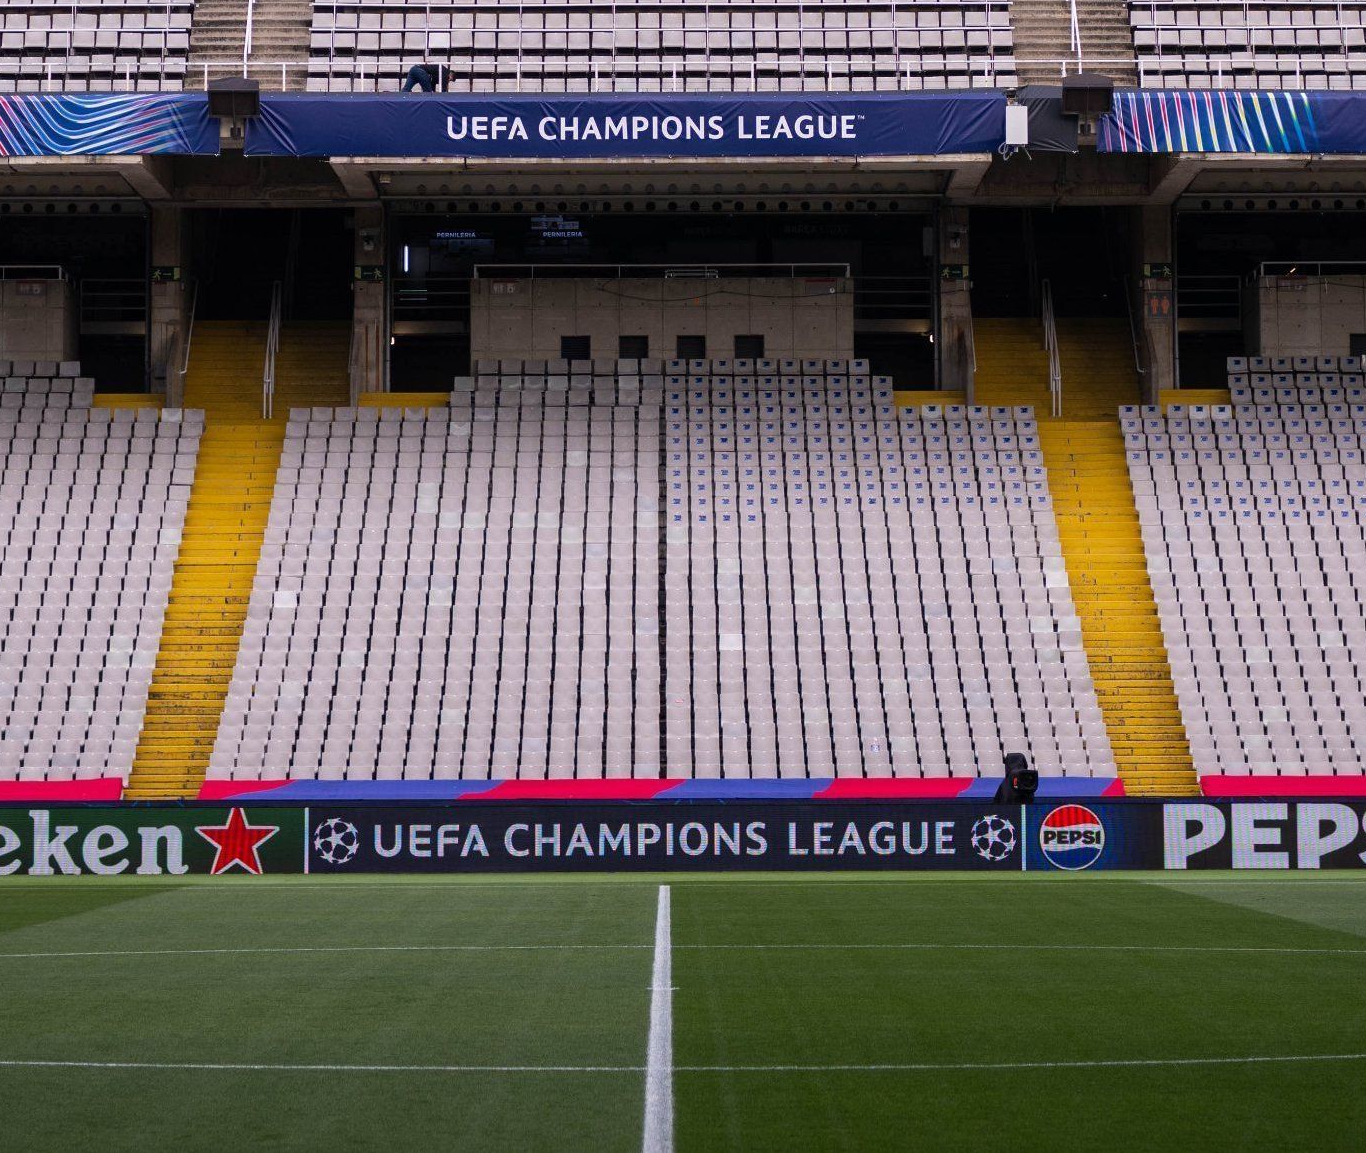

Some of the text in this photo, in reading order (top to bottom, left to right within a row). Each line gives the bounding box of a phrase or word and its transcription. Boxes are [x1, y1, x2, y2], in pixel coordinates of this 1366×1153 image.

[446, 116, 529, 140] UEFA
[538, 116, 724, 140] CHAMPIONS
[374, 821, 956, 857] UEFA CHAMPIONS LEAGUE
[1042, 829, 1102, 845] PEPSI
